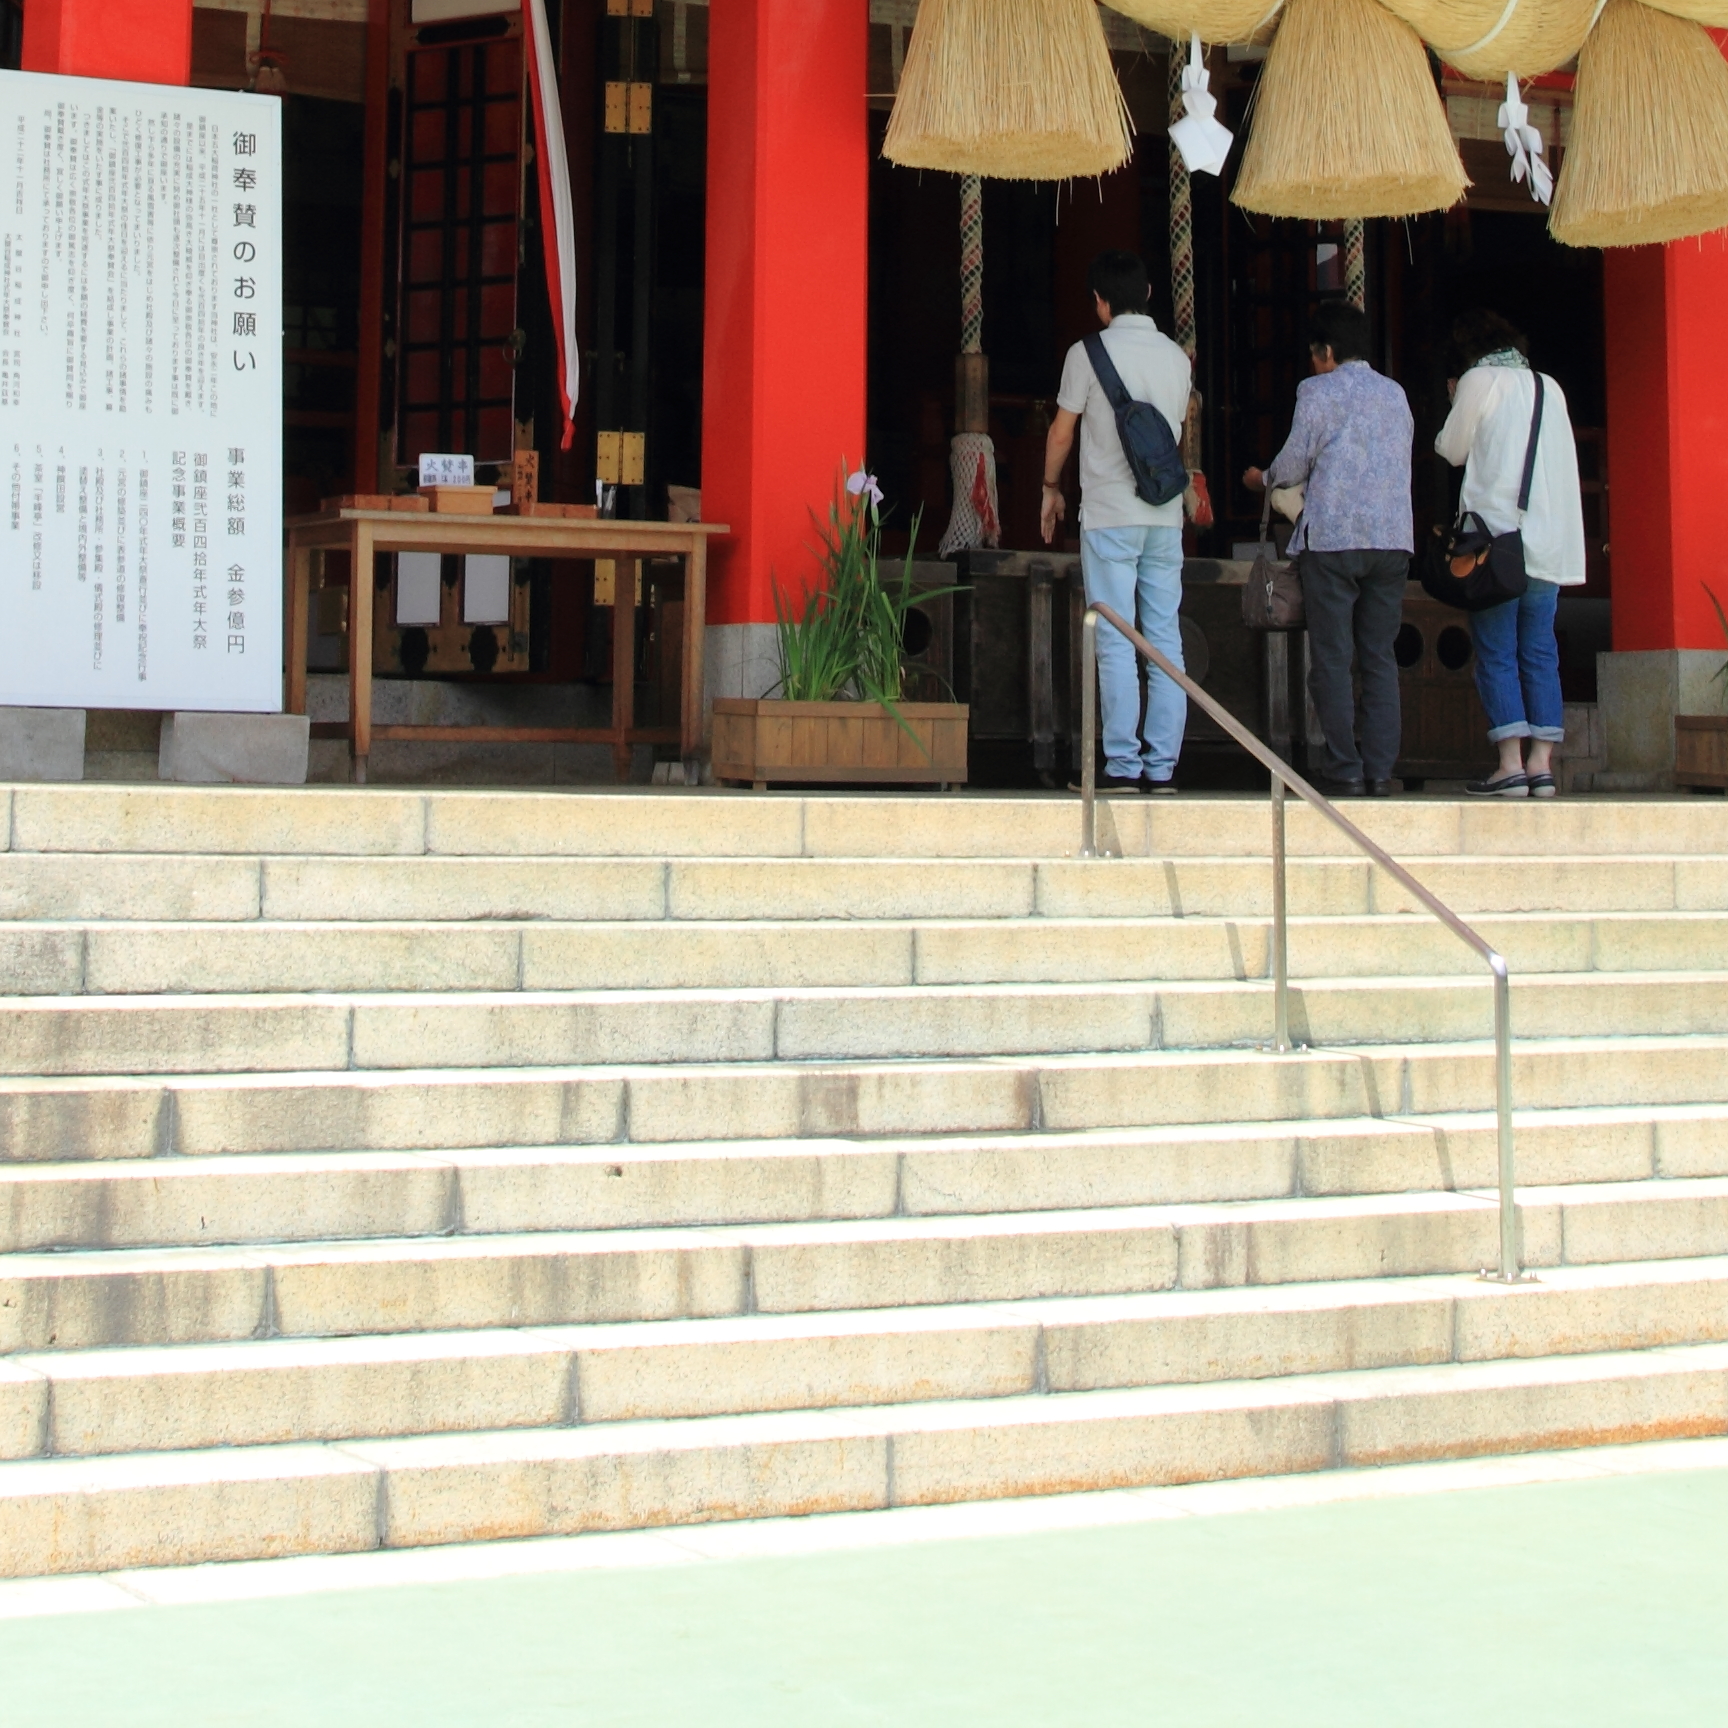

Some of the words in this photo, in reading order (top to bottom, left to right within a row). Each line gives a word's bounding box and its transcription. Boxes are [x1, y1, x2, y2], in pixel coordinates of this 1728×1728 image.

[232, 130, 257, 372] 御奉賛のお願い
[172, 451, 186, 549] 記念事業概要
[227, 447, 245, 536] 事業総額
[193, 452, 207, 650] 御鎮座弐百四拾年式年大祭
[227, 563, 245, 654] 金参億円
